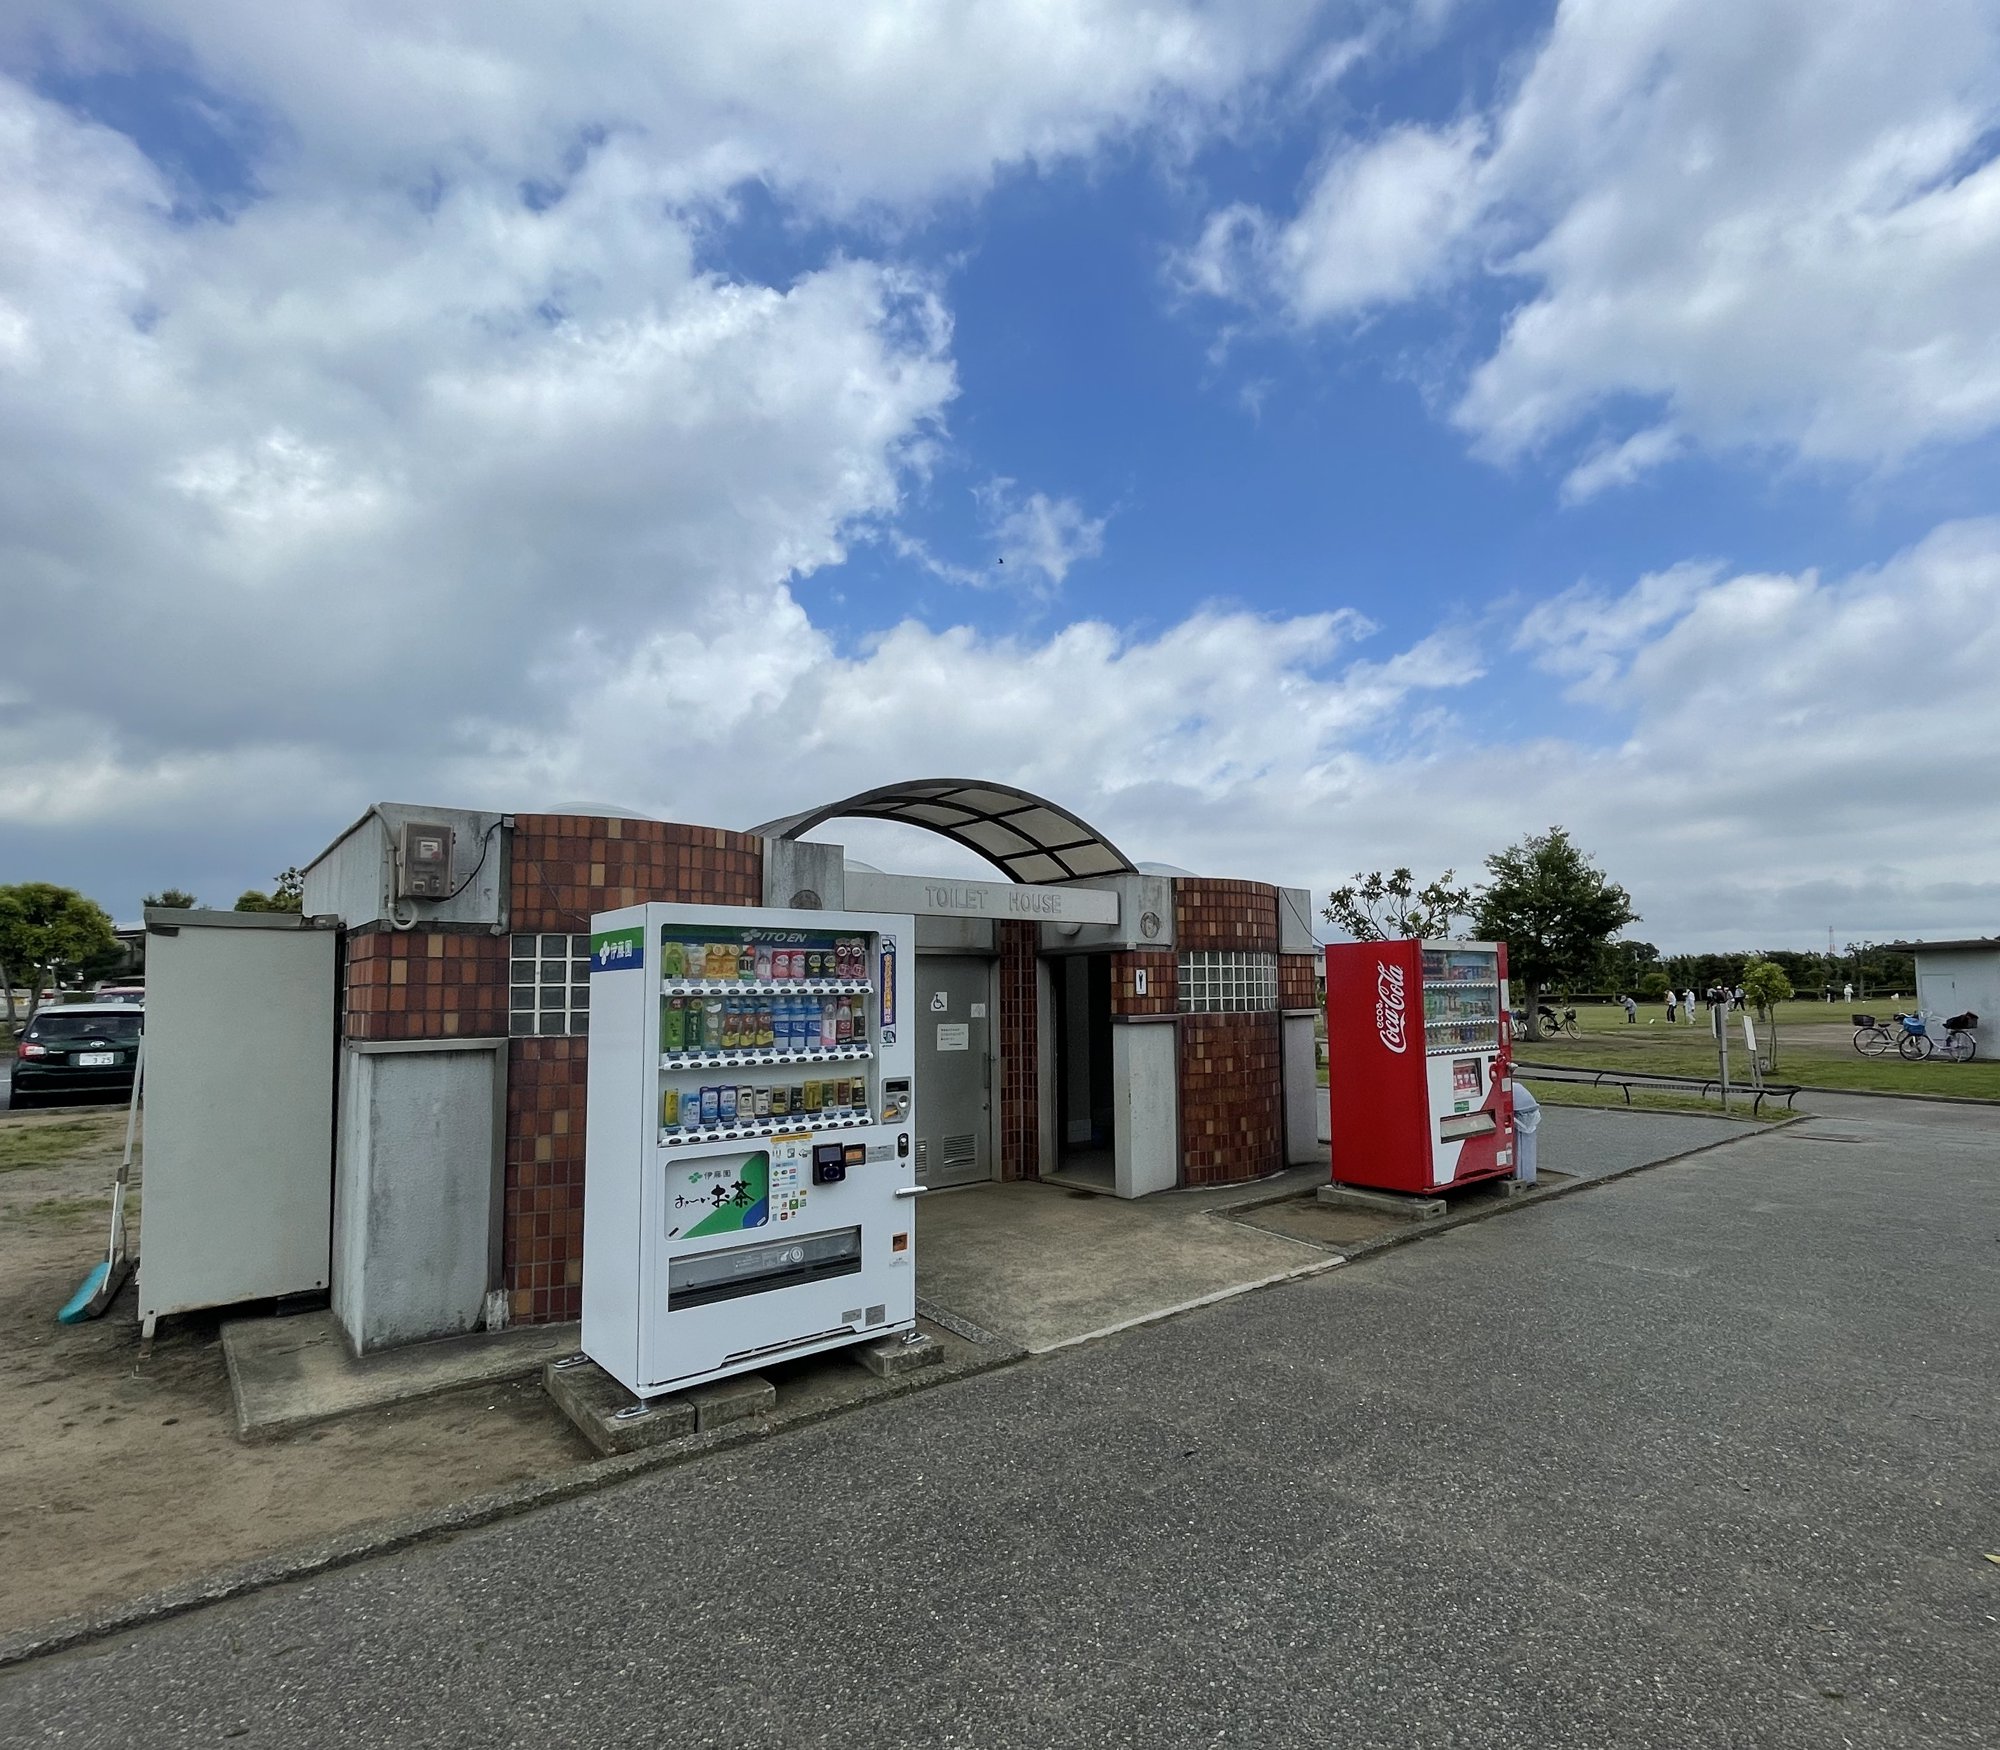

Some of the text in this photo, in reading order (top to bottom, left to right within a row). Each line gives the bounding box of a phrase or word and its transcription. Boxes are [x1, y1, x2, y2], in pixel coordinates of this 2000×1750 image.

[925, 886, 1061, 914] TOILET HOUSE
[760, 931, 786, 942] ITO
[1378, 960, 1406, 1053] Coca-Cola
[703, 1169, 732, 1180] 伊藤園
